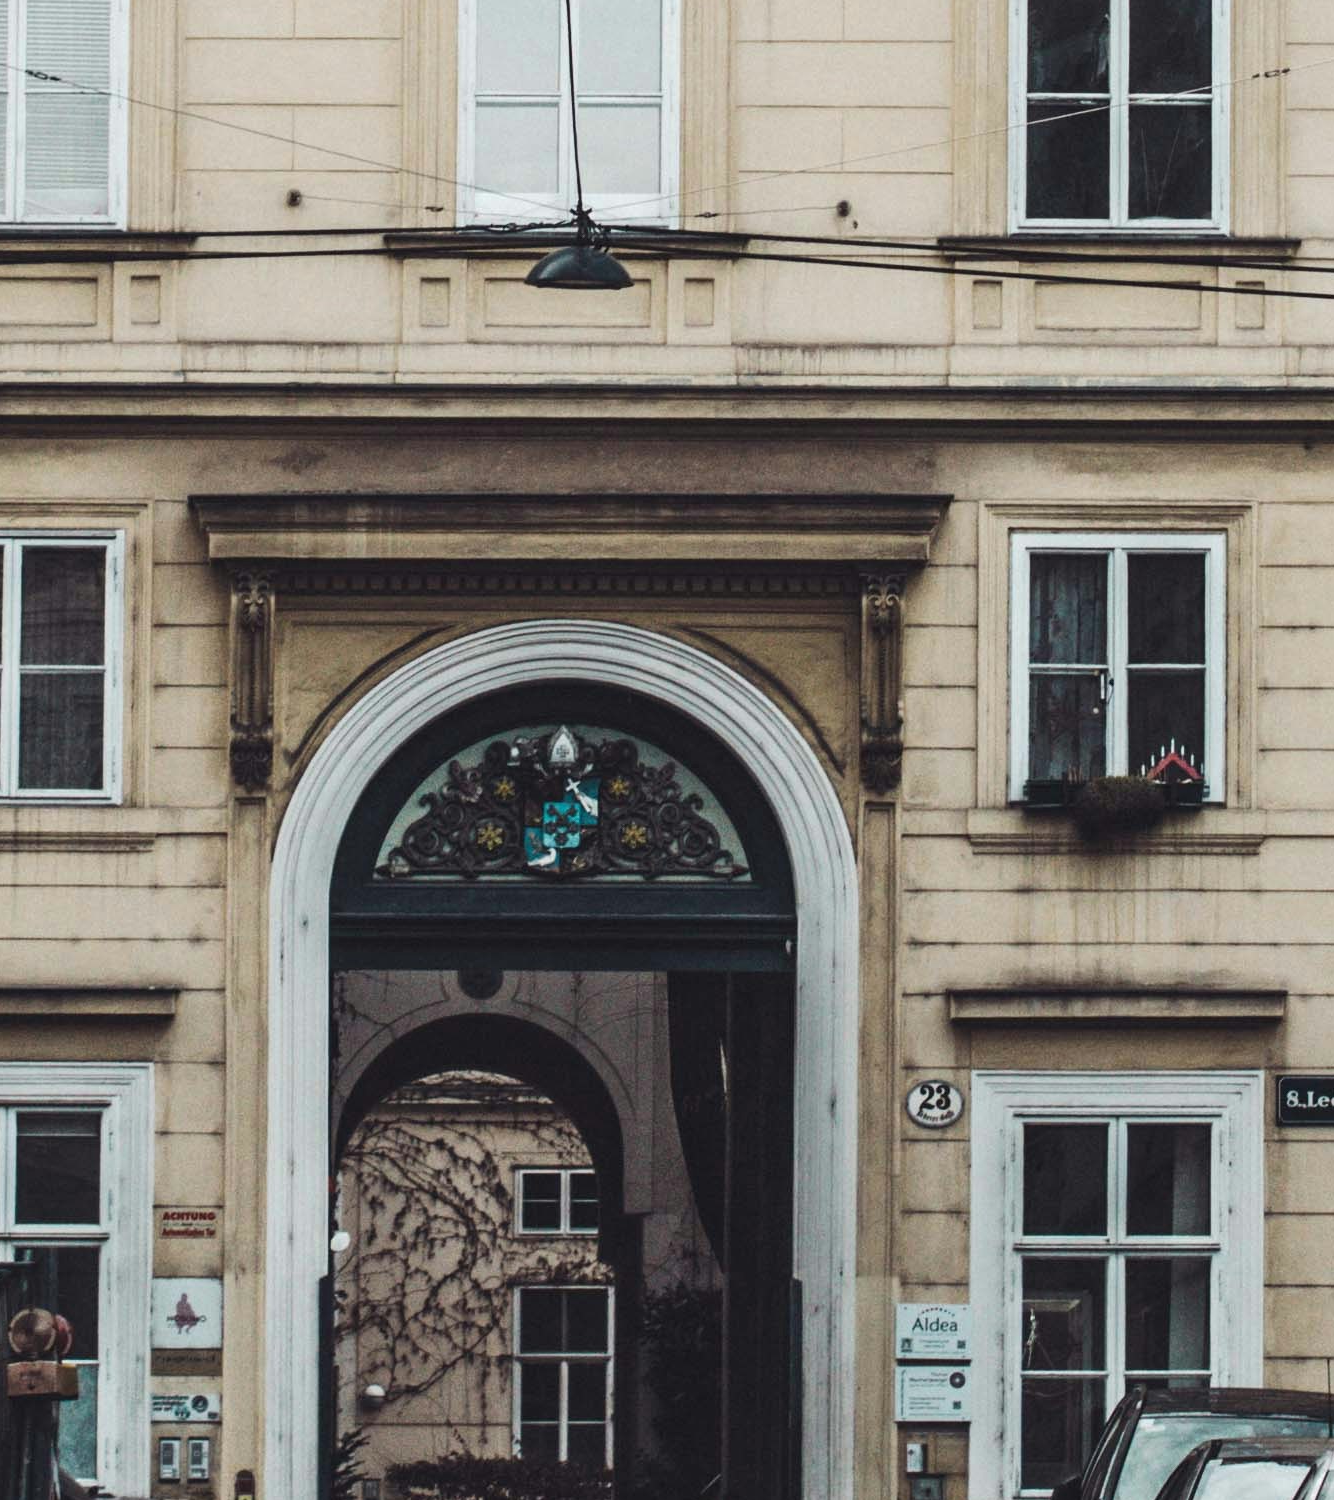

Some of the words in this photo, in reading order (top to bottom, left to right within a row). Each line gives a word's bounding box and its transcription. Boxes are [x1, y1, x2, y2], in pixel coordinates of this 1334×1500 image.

[919, 1084, 952, 1112] 23
[162, 1211, 217, 1221] ACHTUNG
[912, 1316, 959, 1333] Aldea
